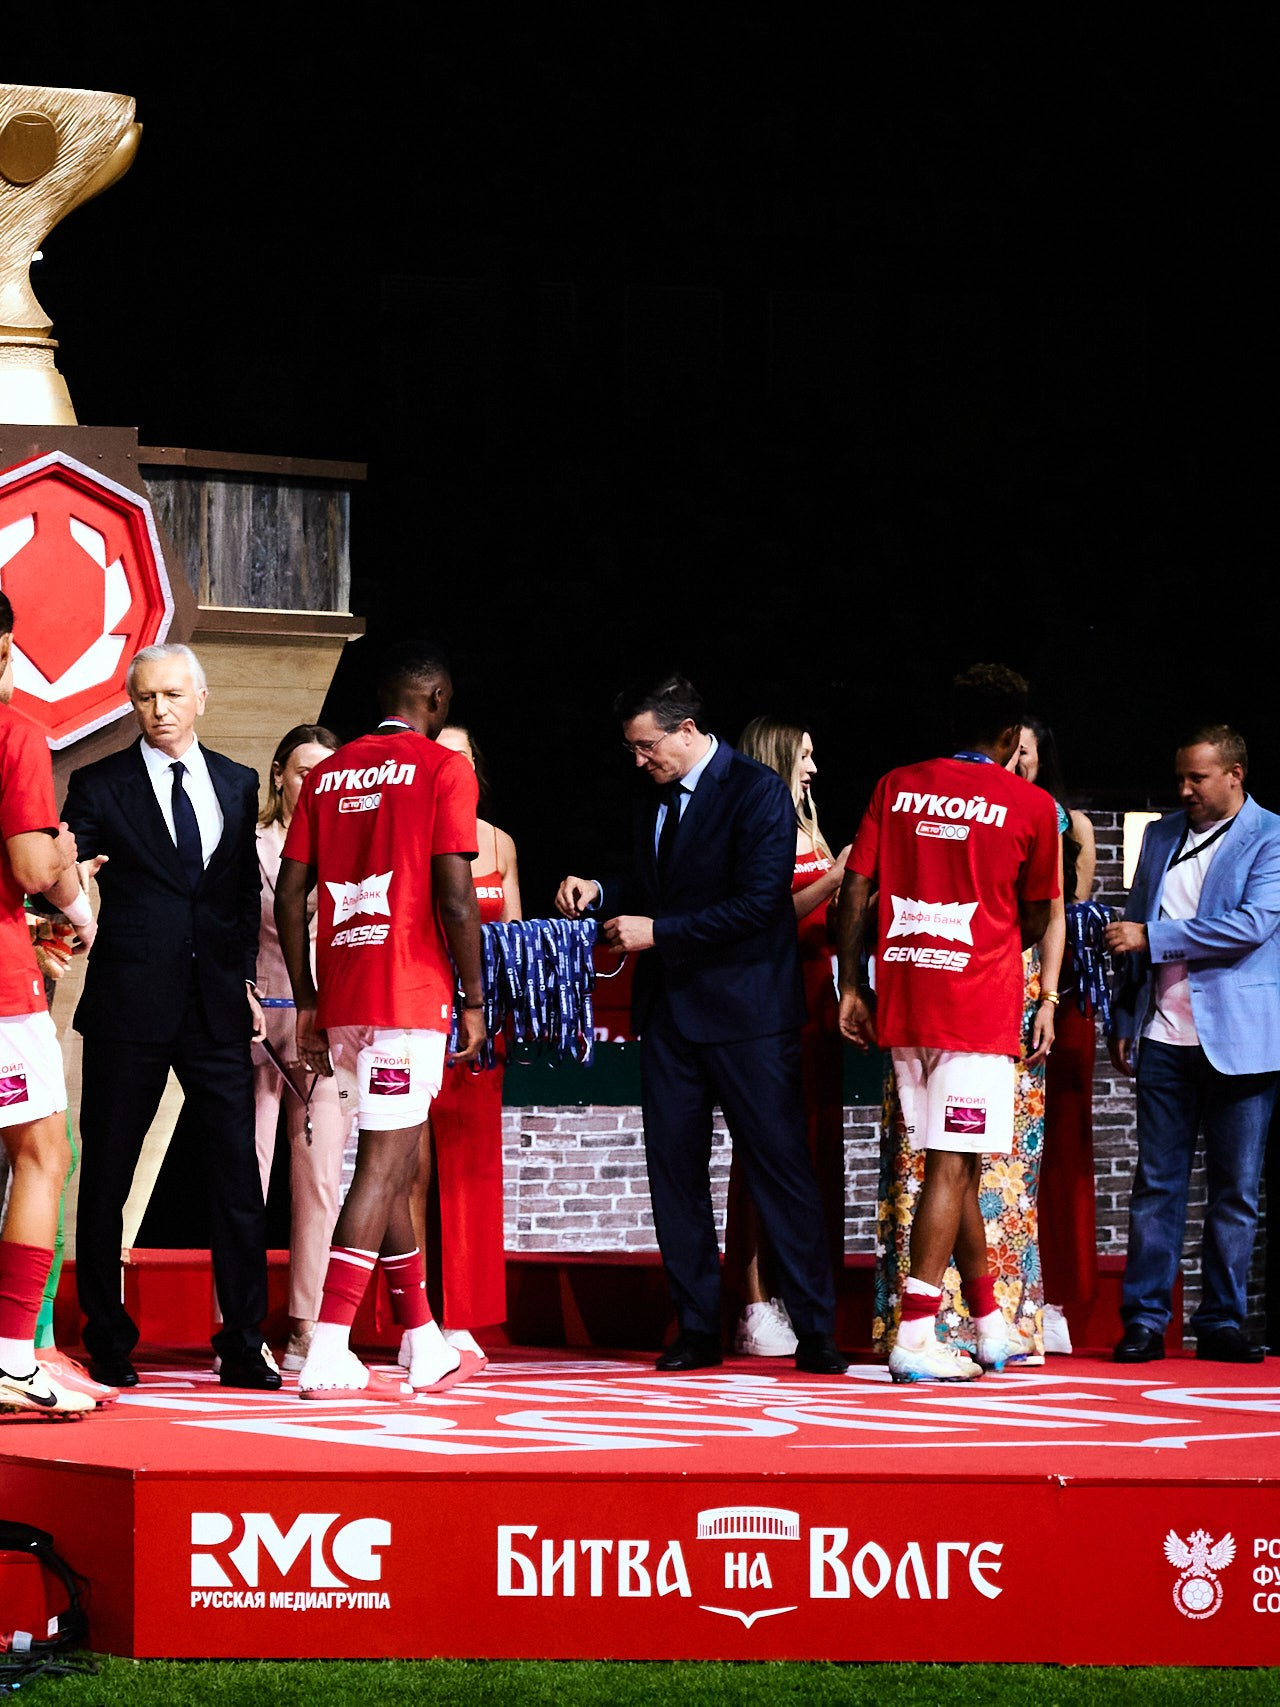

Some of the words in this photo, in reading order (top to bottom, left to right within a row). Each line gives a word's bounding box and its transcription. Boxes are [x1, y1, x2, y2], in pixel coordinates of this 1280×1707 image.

[315, 759, 416, 794] ЛУКОЙЛ
[891, 791, 1008, 828] ЛУКОЙЛ
[940, 826, 968, 839] 100
[899, 910, 931, 926] Альфа
[933, 913, 963, 925] Банк
[882, 946, 972, 968] GENESIS
[372, 1056, 410, 1065] ЛУКОЙЛ
[946, 1095, 986, 1105] ЛУКОЙЛ
[191, 1512, 392, 1588] RMG
[190, 1591, 265, 1609] РУССКАЯ
[269, 1592, 391, 1611] МЕДИАГРУППА
